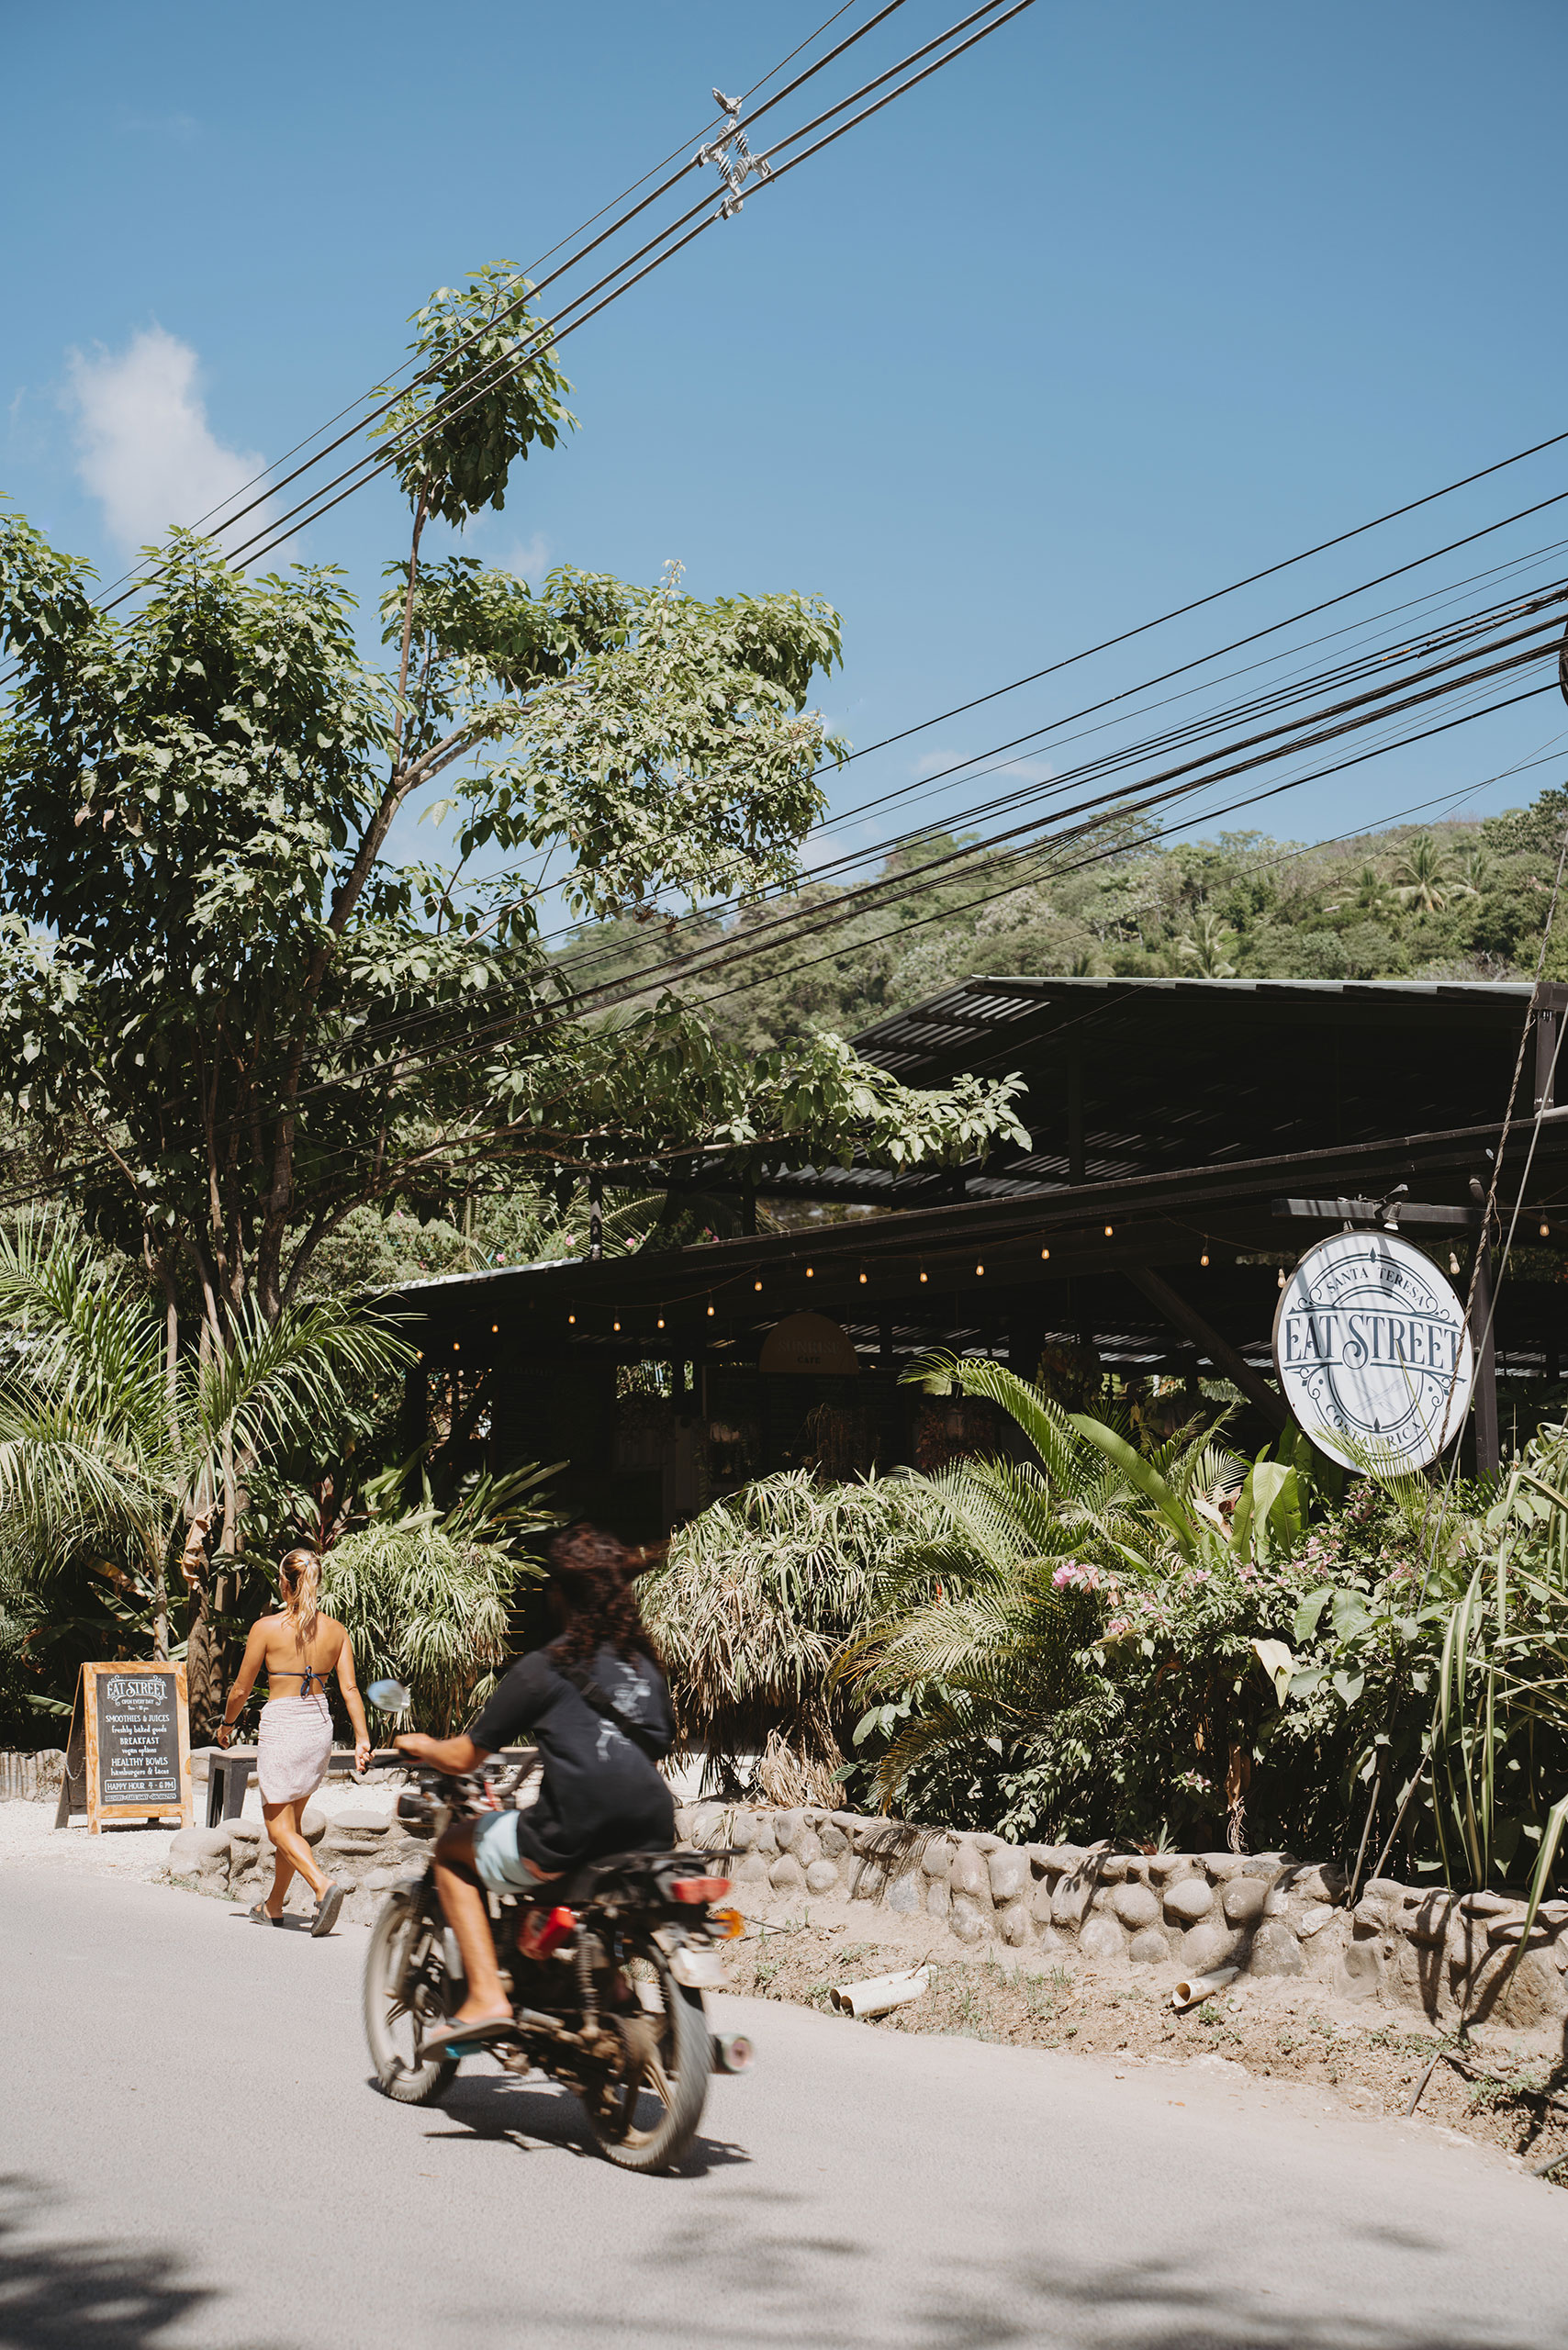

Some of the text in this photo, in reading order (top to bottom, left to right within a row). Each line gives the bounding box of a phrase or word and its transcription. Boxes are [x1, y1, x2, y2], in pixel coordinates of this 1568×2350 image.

[1327, 1267, 1425, 1306] SANTA TERESA
[1284, 1314, 1462, 1374] EAT STREET
[1386, 1421, 1421, 1448] RICA
[106, 1681, 167, 1697] EAT STREET
[105, 1714, 141, 1723] SMOOTHIES
[148, 1714, 170, 1722] JUICES
[111, 1724, 167, 1735] freshly baked goods
[119, 1737, 160, 1745] BREAKFAST
[121, 1745, 157, 1756] vegan options
[111, 1756, 169, 1766] HEALTHY BOWLS
[110, 1766, 170, 1777] hamburgers & tacos
[106, 1782, 128, 1790] HAPPY
[148, 1781, 153, 1789] 4
[159, 1781, 163, 1789] 6
[164, 1781, 174, 1789] PM
